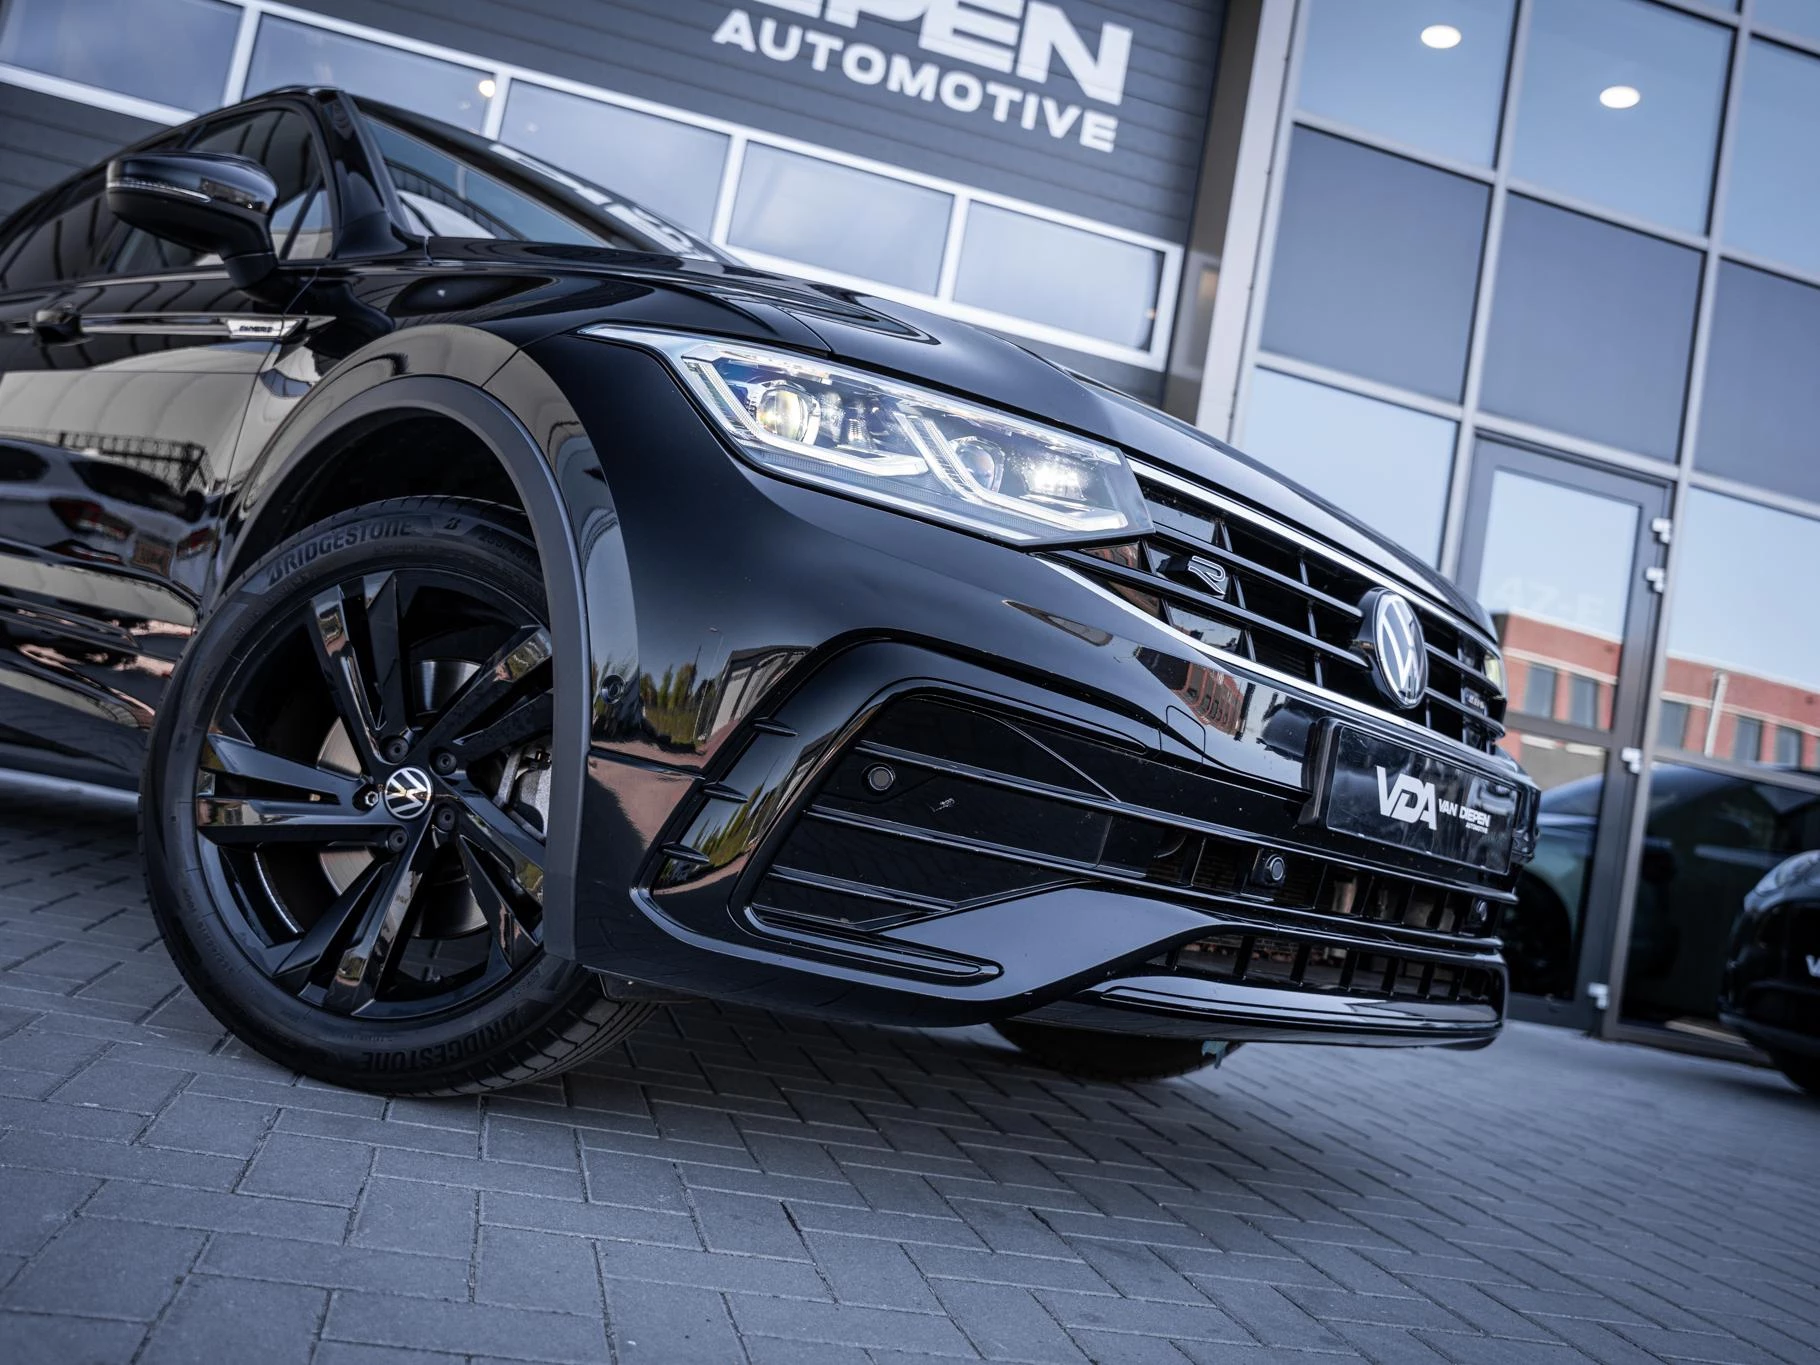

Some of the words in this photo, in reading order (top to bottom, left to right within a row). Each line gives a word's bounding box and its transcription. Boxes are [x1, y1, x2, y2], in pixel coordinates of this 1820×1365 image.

[711, 9, 1119, 153] AUTOMOTIVE
[745, 0, 1133, 106] EN
[266, 515, 413, 587] BRIDGESTONE
[1376, 765, 1437, 831] VDA
[1438, 797, 1458, 817] VAN
[1459, 805, 1491, 828] DIEPEN
[360, 1008, 527, 1074] BRIDGESTONE
